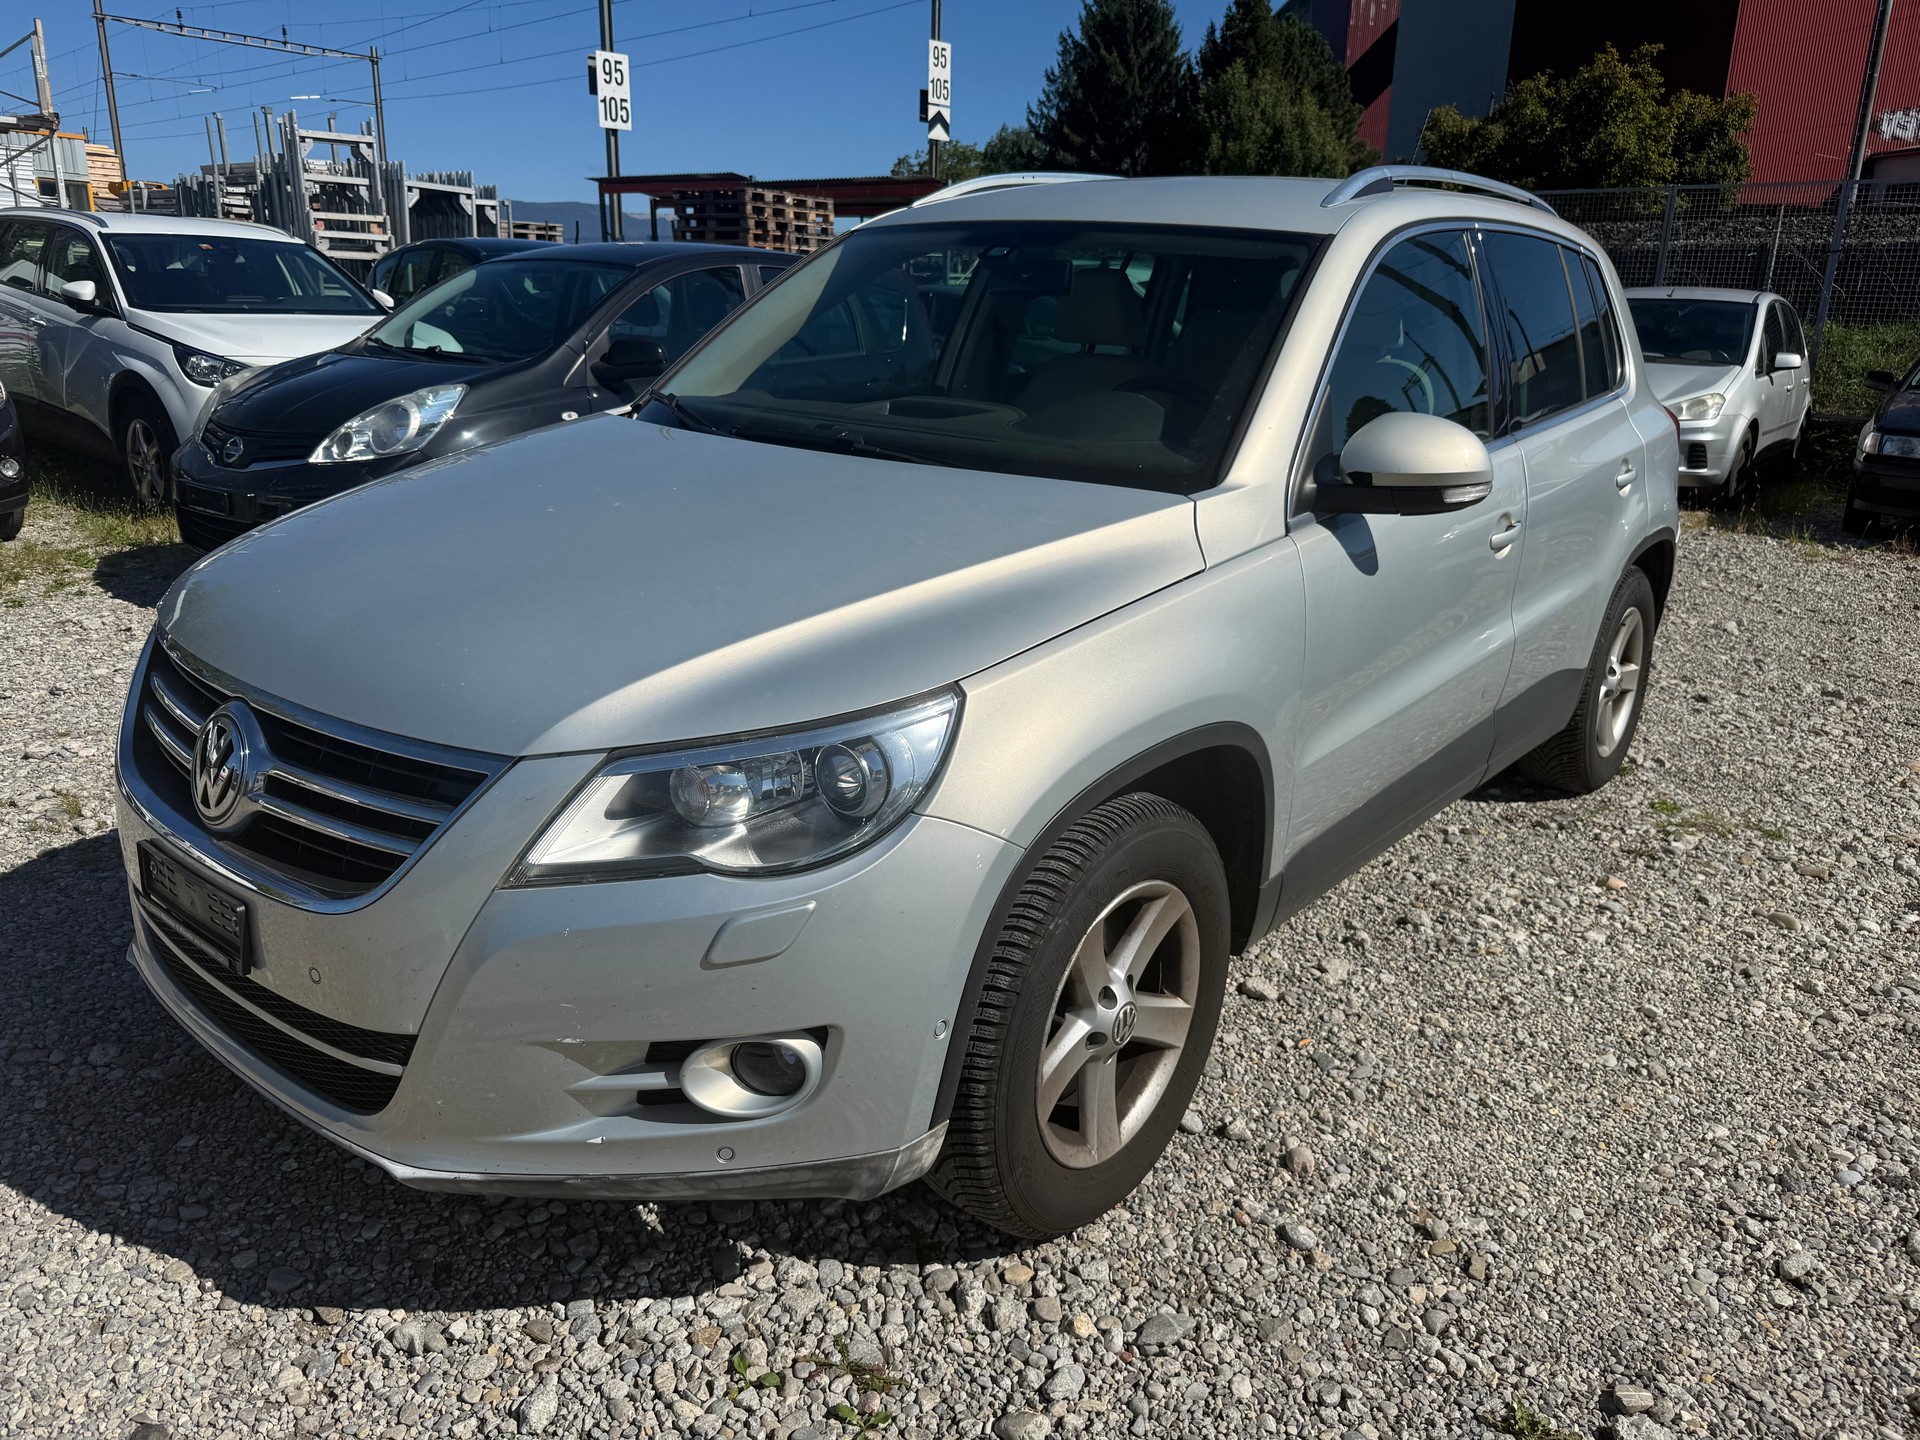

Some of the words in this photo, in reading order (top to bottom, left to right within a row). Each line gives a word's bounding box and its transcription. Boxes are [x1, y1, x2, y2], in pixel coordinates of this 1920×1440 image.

[933, 46, 947, 69] 95
[602, 58, 624, 87] 95
[930, 77, 949, 101] 105
[600, 95, 630, 124] 105
[195, 714, 243, 822] VW
[1114, 1003, 1136, 1044] VW
